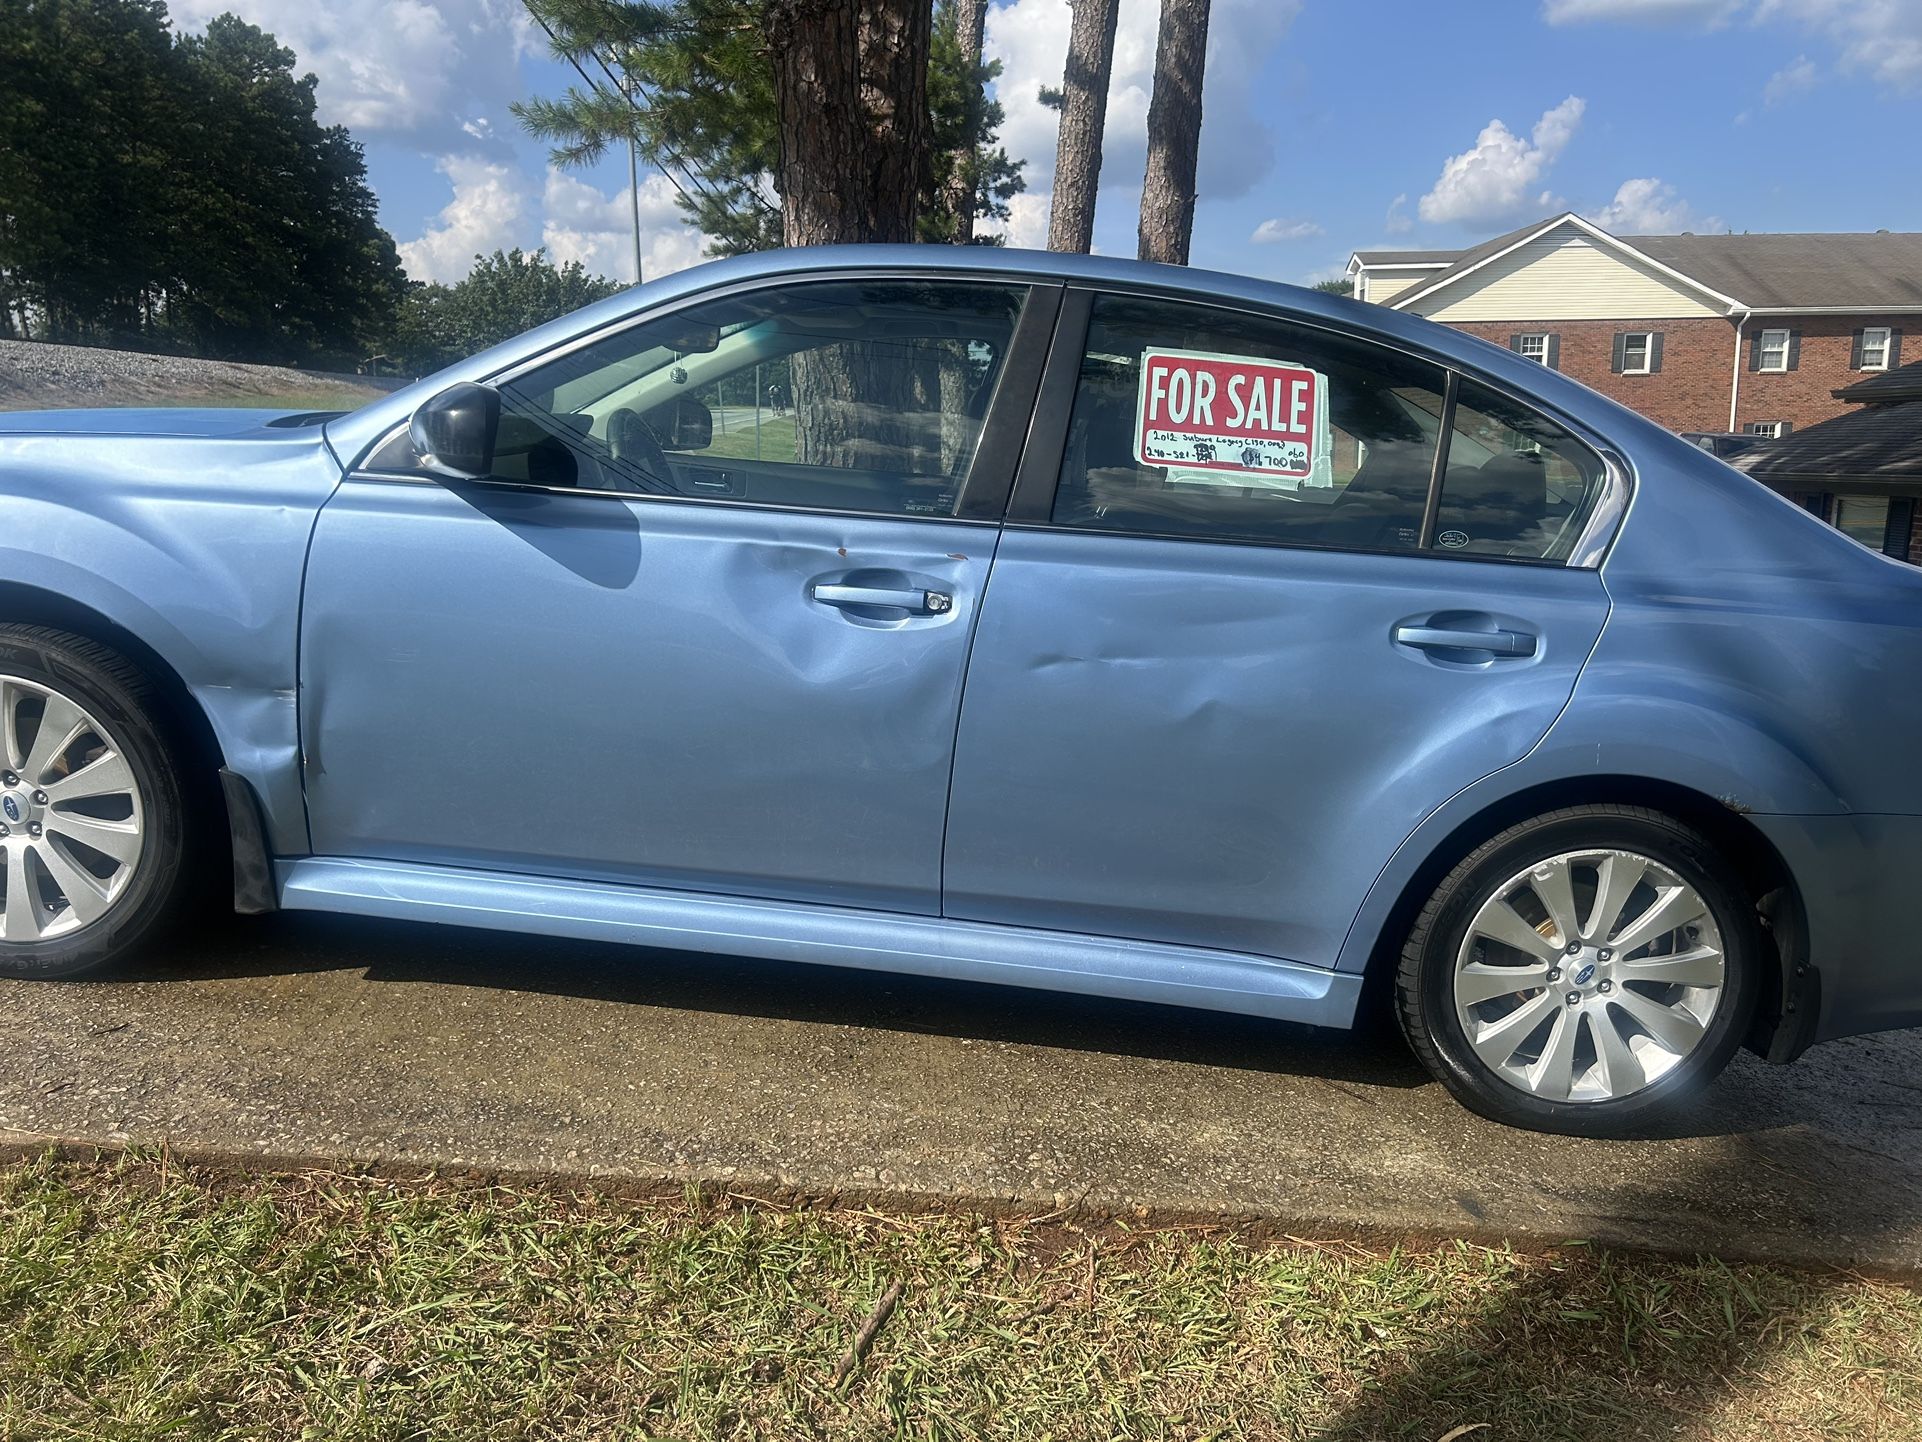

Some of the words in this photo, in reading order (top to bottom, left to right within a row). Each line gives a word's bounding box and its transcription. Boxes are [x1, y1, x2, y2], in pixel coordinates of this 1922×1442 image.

[1149, 366, 1217, 426] FOR
[1225, 375, 1308, 434] SALE
[1154, 430, 1178, 442] 2012
